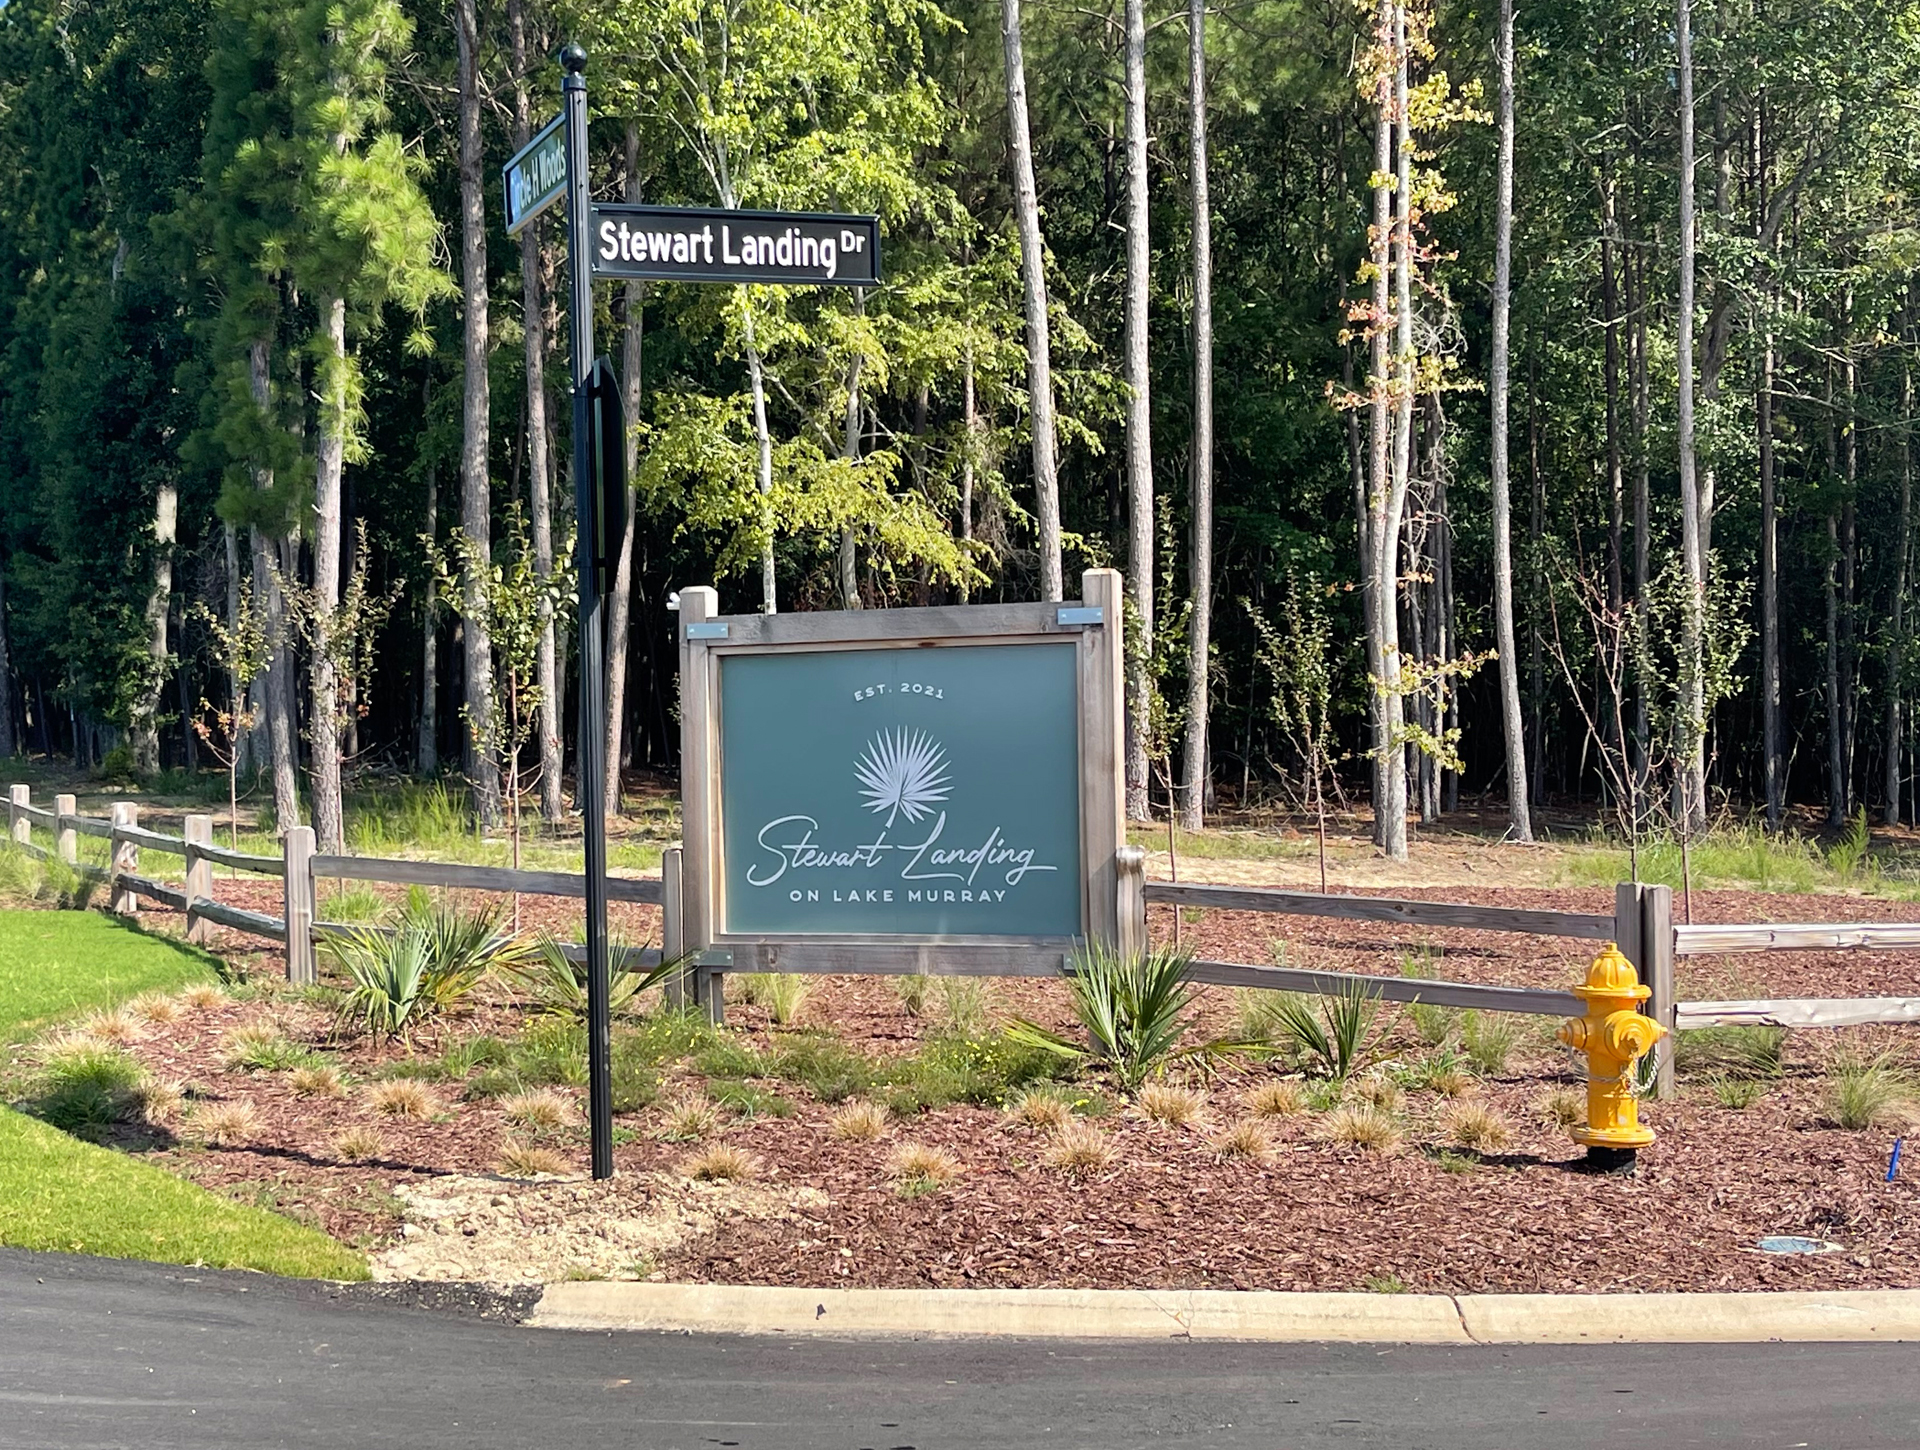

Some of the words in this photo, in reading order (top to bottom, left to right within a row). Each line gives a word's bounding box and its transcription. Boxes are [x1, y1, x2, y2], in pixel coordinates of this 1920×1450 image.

[532, 155, 540, 199] H
[539, 137, 567, 192] Woods
[600, 220, 714, 264] Stewart
[722, 225, 837, 279] Landing
[840, 230, 866, 253] Dr
[854, 684, 892, 701] EST.
[900, 682, 944, 699] 2021
[746, 814, 893, 886] Stewart
[897, 810, 1058, 886] Landing
[789, 889, 819, 902] ON
[833, 889, 893, 902] LAKE
[907, 889, 1006, 902] MURRAY
